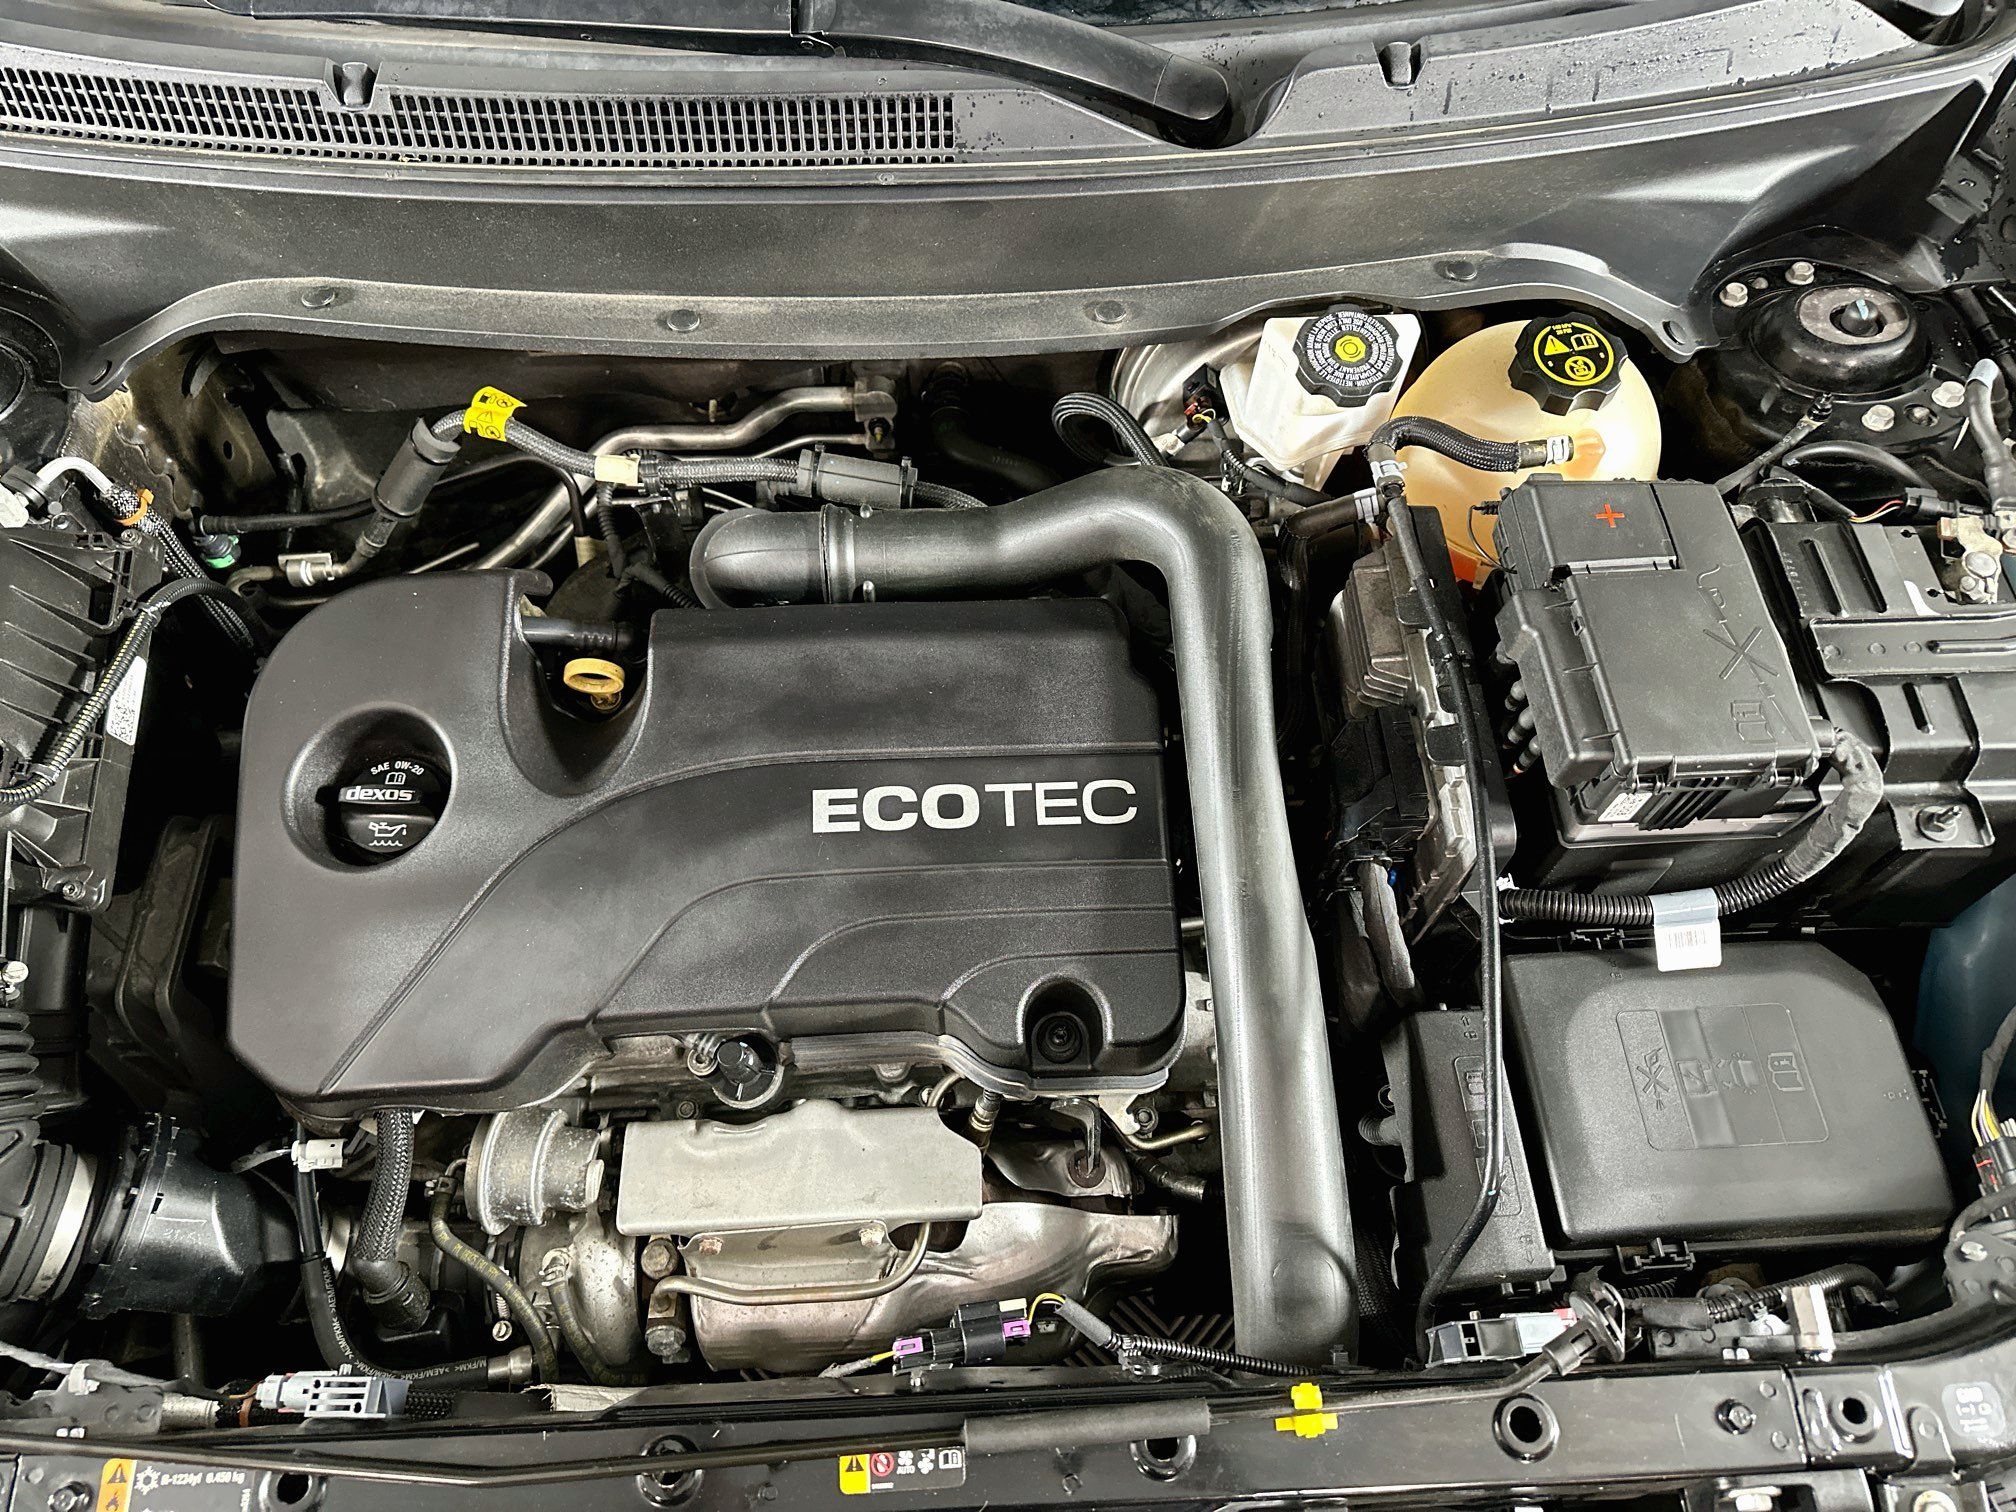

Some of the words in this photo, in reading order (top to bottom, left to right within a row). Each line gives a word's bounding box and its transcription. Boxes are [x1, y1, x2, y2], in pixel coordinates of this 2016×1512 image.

[1325, 374, 1352, 386] NETTOYER
[370, 761, 390, 775] SAE
[394, 760, 425, 776] 0W-20
[345, 785, 413, 801] dexos
[812, 779, 1138, 833] ECOTEC
[896, 1465, 915, 1475] AUTO
[232, 1471, 245, 1484] kg
